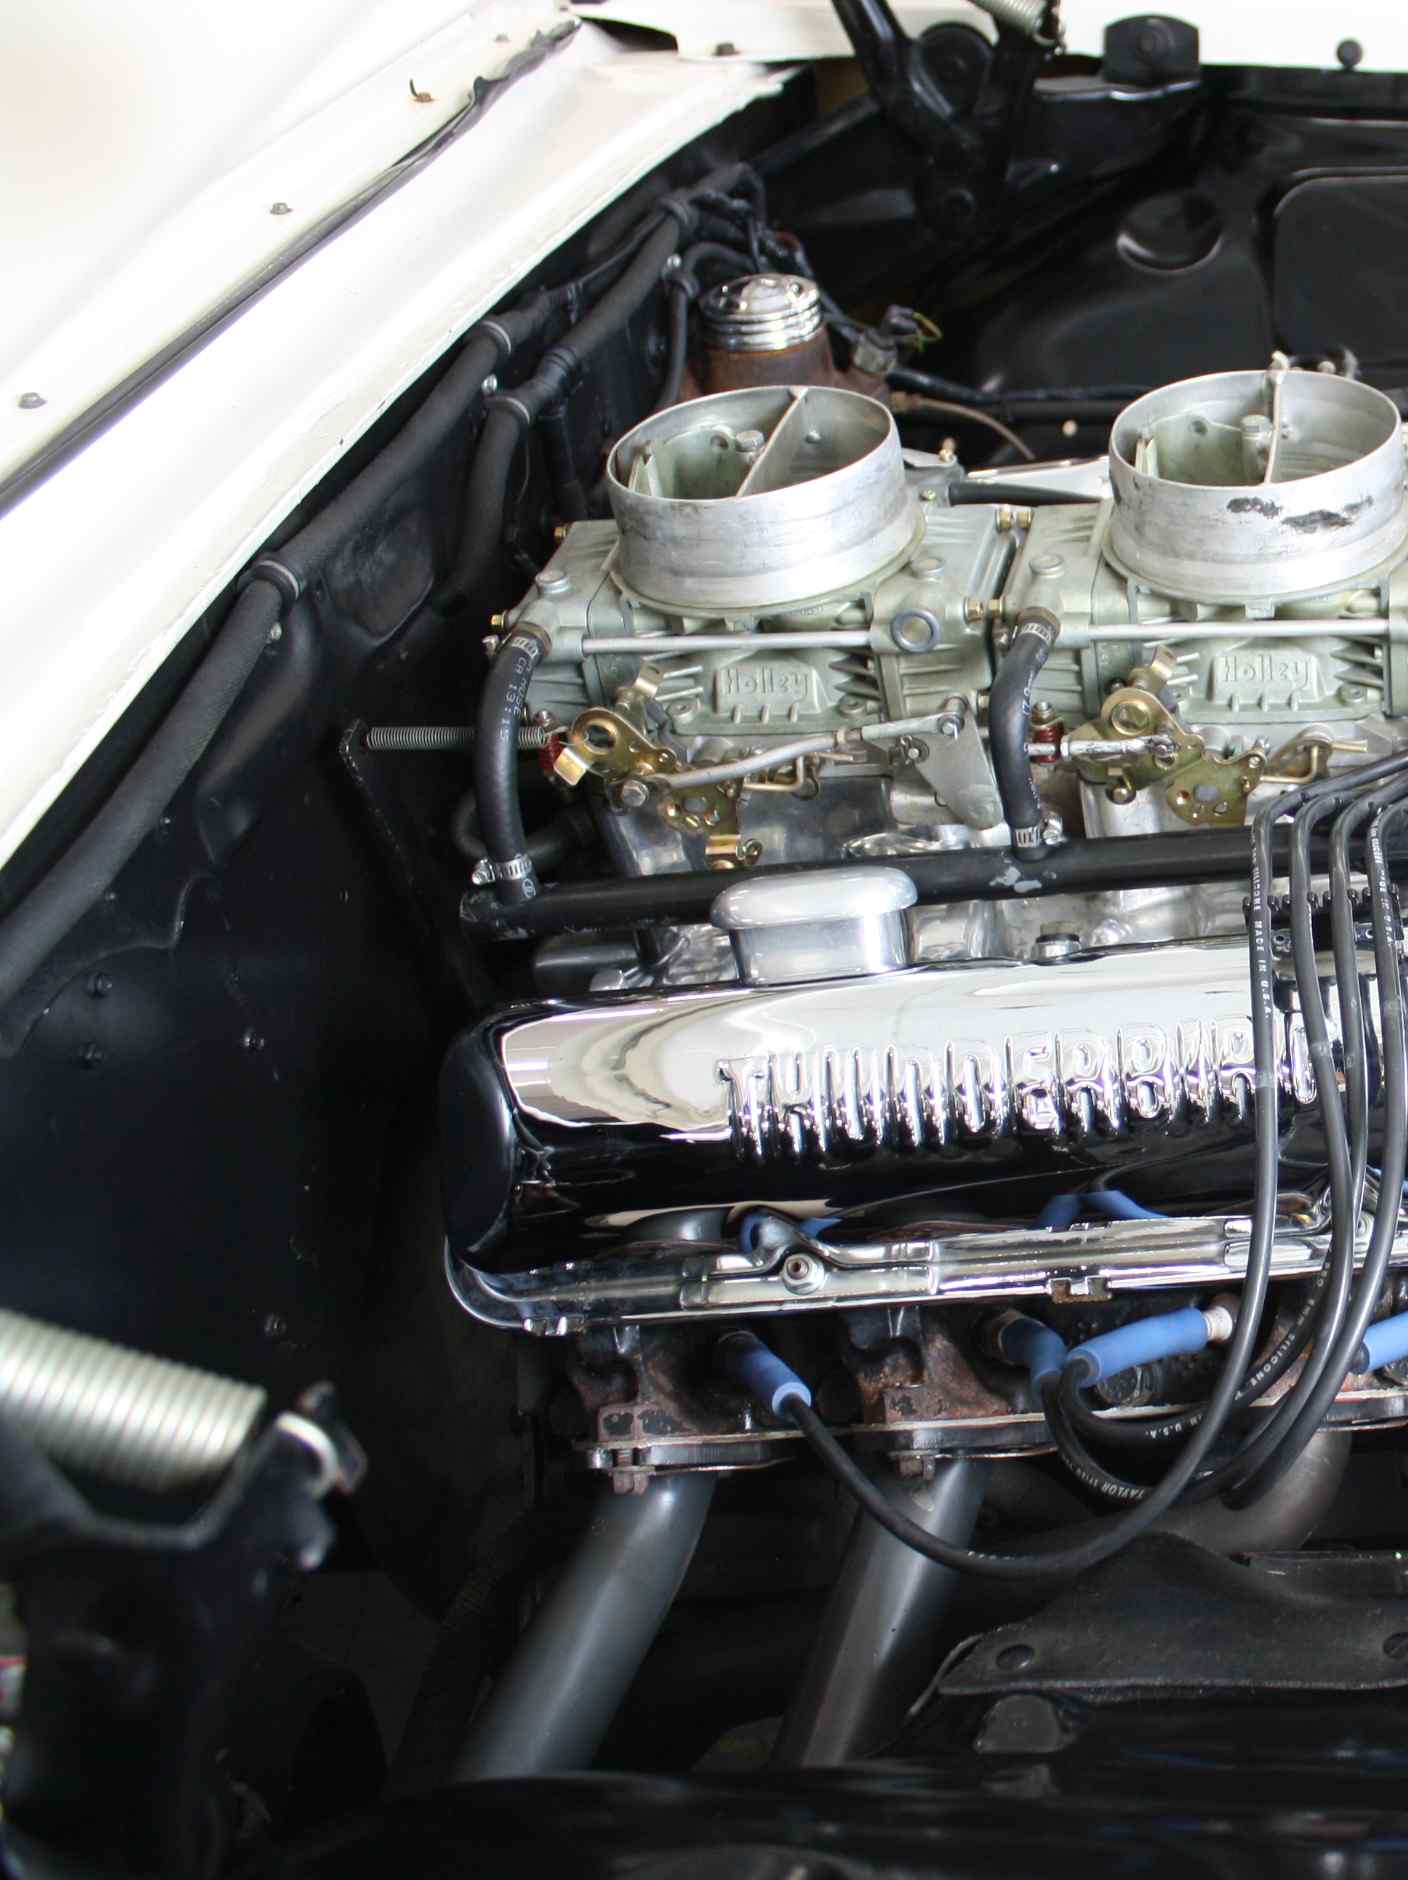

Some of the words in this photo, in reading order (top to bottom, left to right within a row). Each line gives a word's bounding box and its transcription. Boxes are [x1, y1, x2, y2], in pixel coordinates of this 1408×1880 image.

[722, 667, 811, 699] Holley
[1220, 655, 1313, 687] Holley
[1253, 920, 1265, 951] MADE
[1258, 959, 1267, 972] IN
[1260, 980, 1272, 1019] U.S.A.
[1251, 1333, 1296, 1386] SILICONE
[1145, 1422, 1182, 1439] U.S.A.
[1101, 1481, 1145, 1500] TAYLOR
